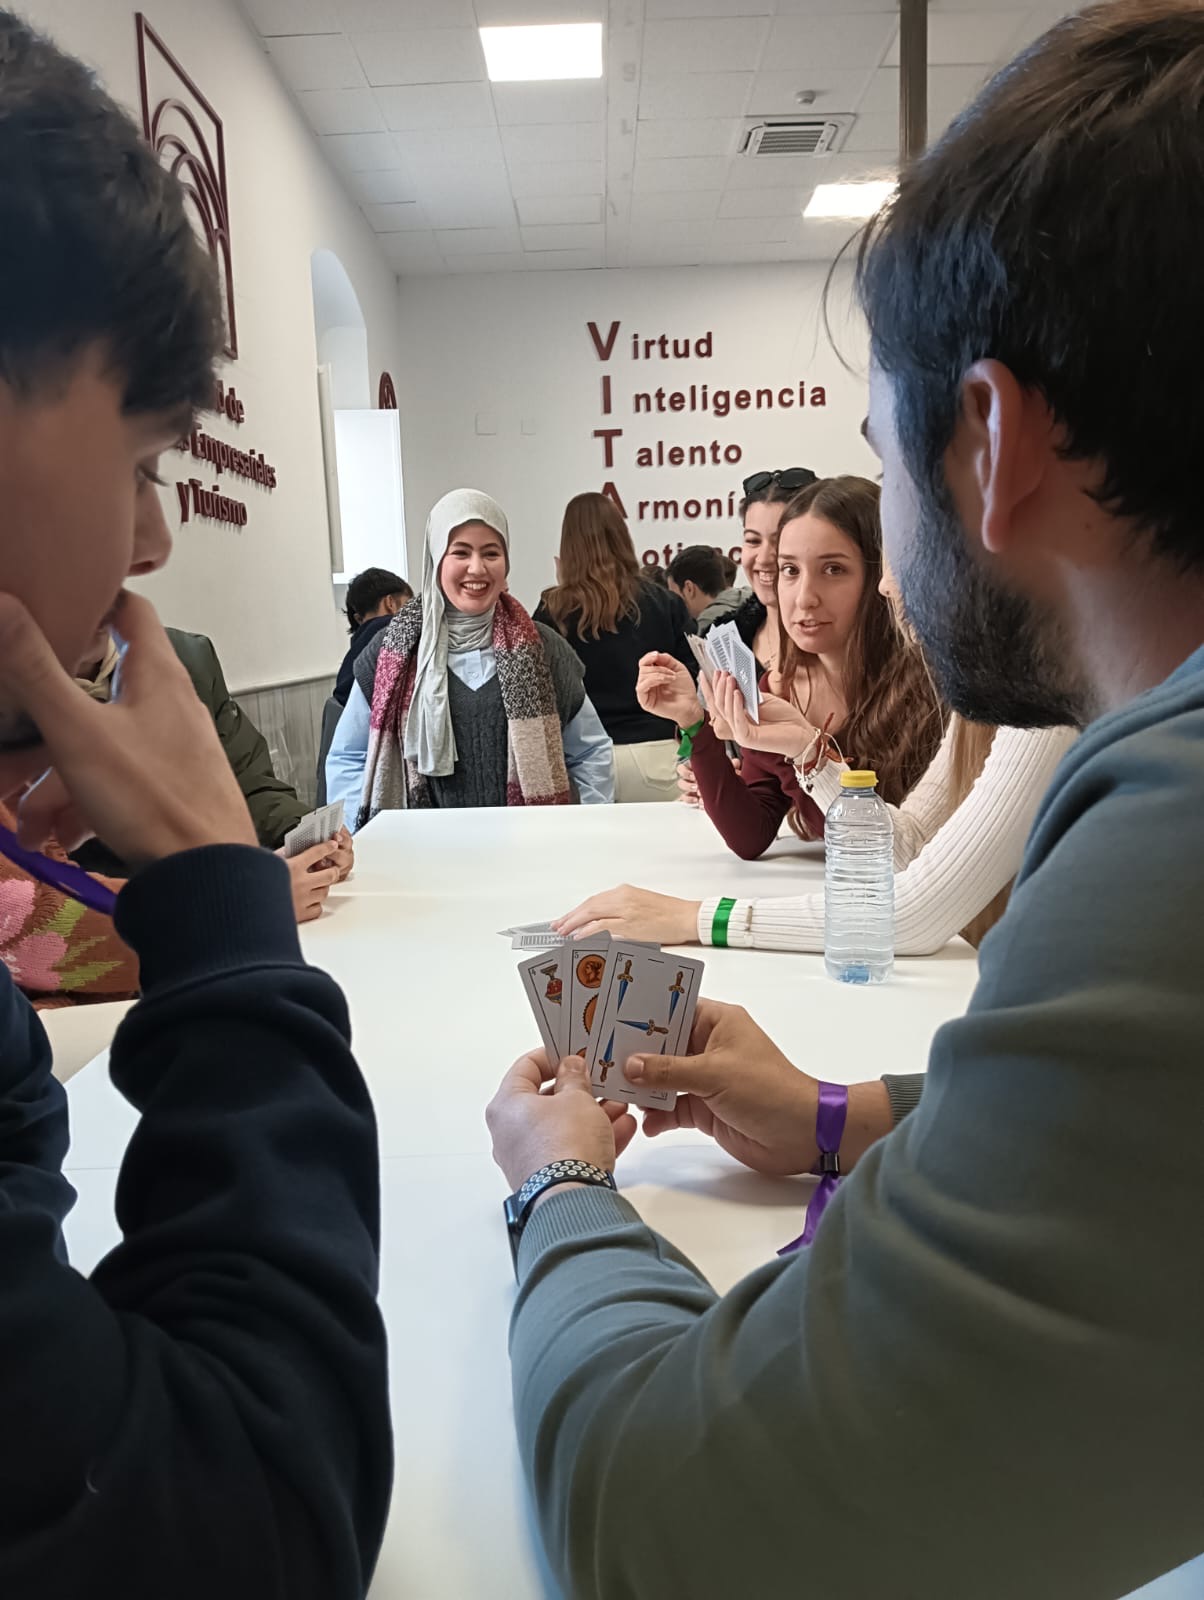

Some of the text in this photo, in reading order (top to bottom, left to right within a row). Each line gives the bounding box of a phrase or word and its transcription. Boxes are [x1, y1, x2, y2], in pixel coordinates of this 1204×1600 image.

[587, 321, 713, 361] Virtud
[225, 387, 245, 424] de
[602, 375, 826, 417] Inteligencia
[191, 424, 277, 489] Empresariales
[593, 429, 742, 468] Talento
[188, 478, 248, 526] Turismo
[601, 481, 736, 520] Armoní
